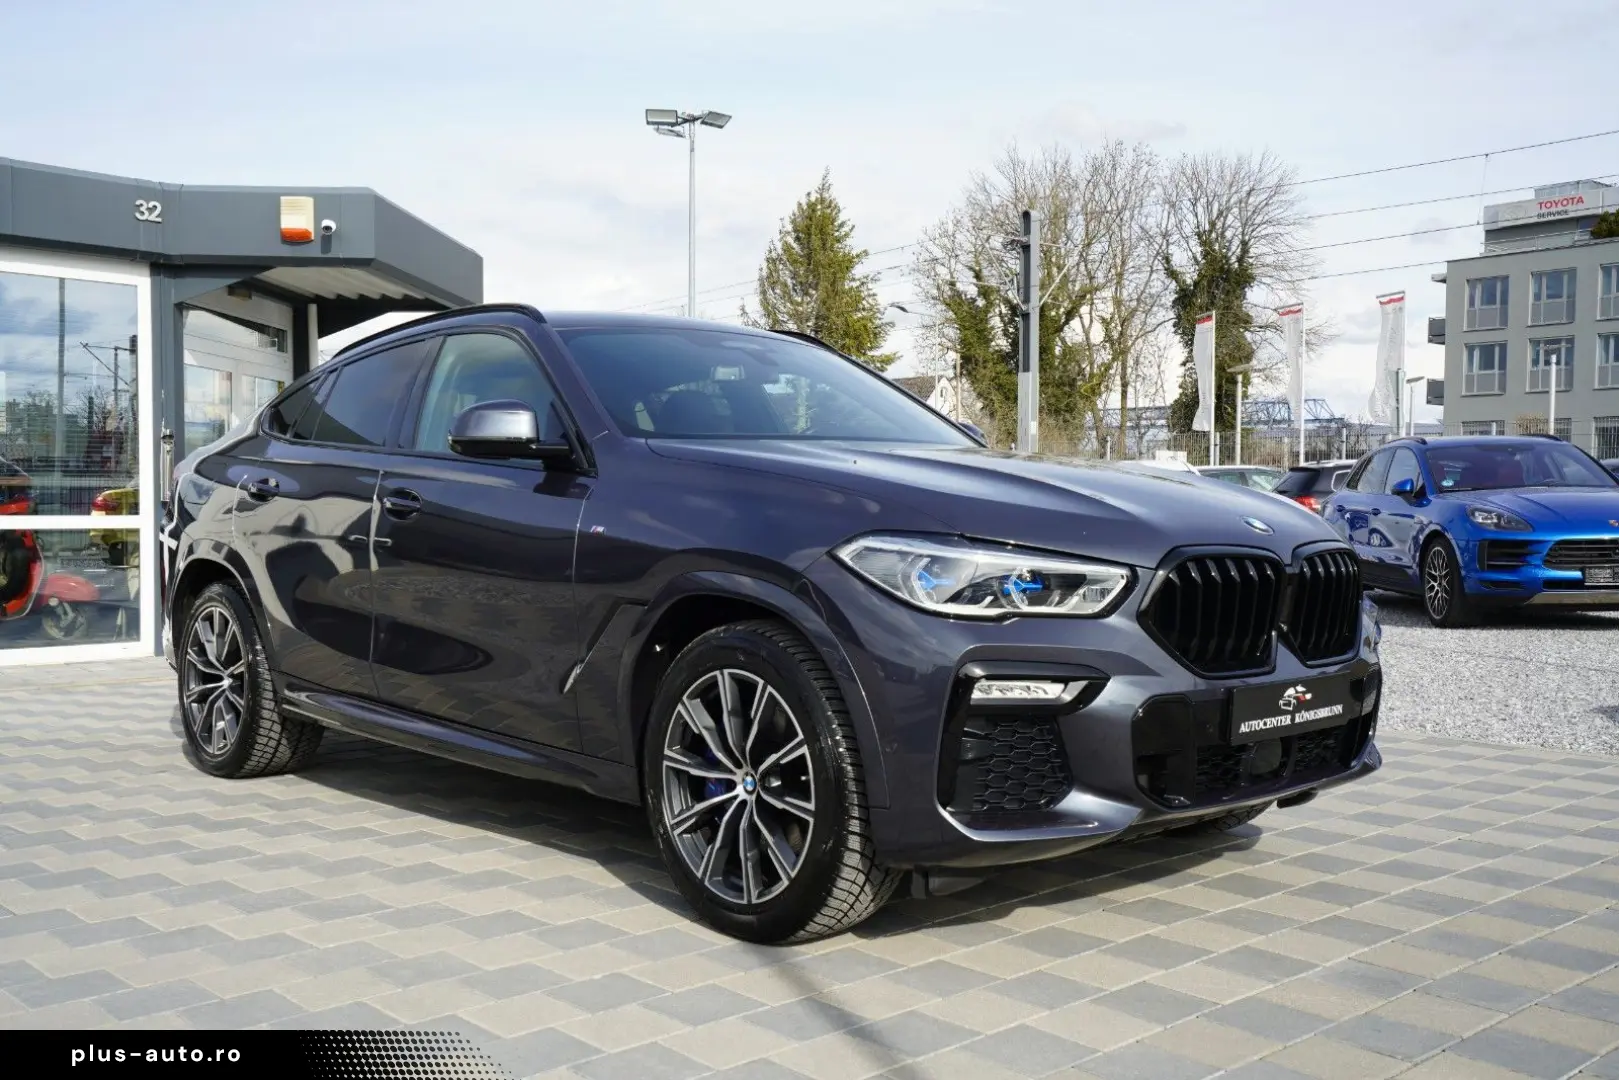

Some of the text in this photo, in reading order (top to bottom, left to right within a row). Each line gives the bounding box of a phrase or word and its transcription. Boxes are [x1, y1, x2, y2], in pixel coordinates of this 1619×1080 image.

[134, 199, 162, 222] 32
[1537, 195, 1585, 211] TOYOTA
[1537, 209, 1569, 219] SERVICE
[1239, 714, 1292, 733] AUTOCENTER
